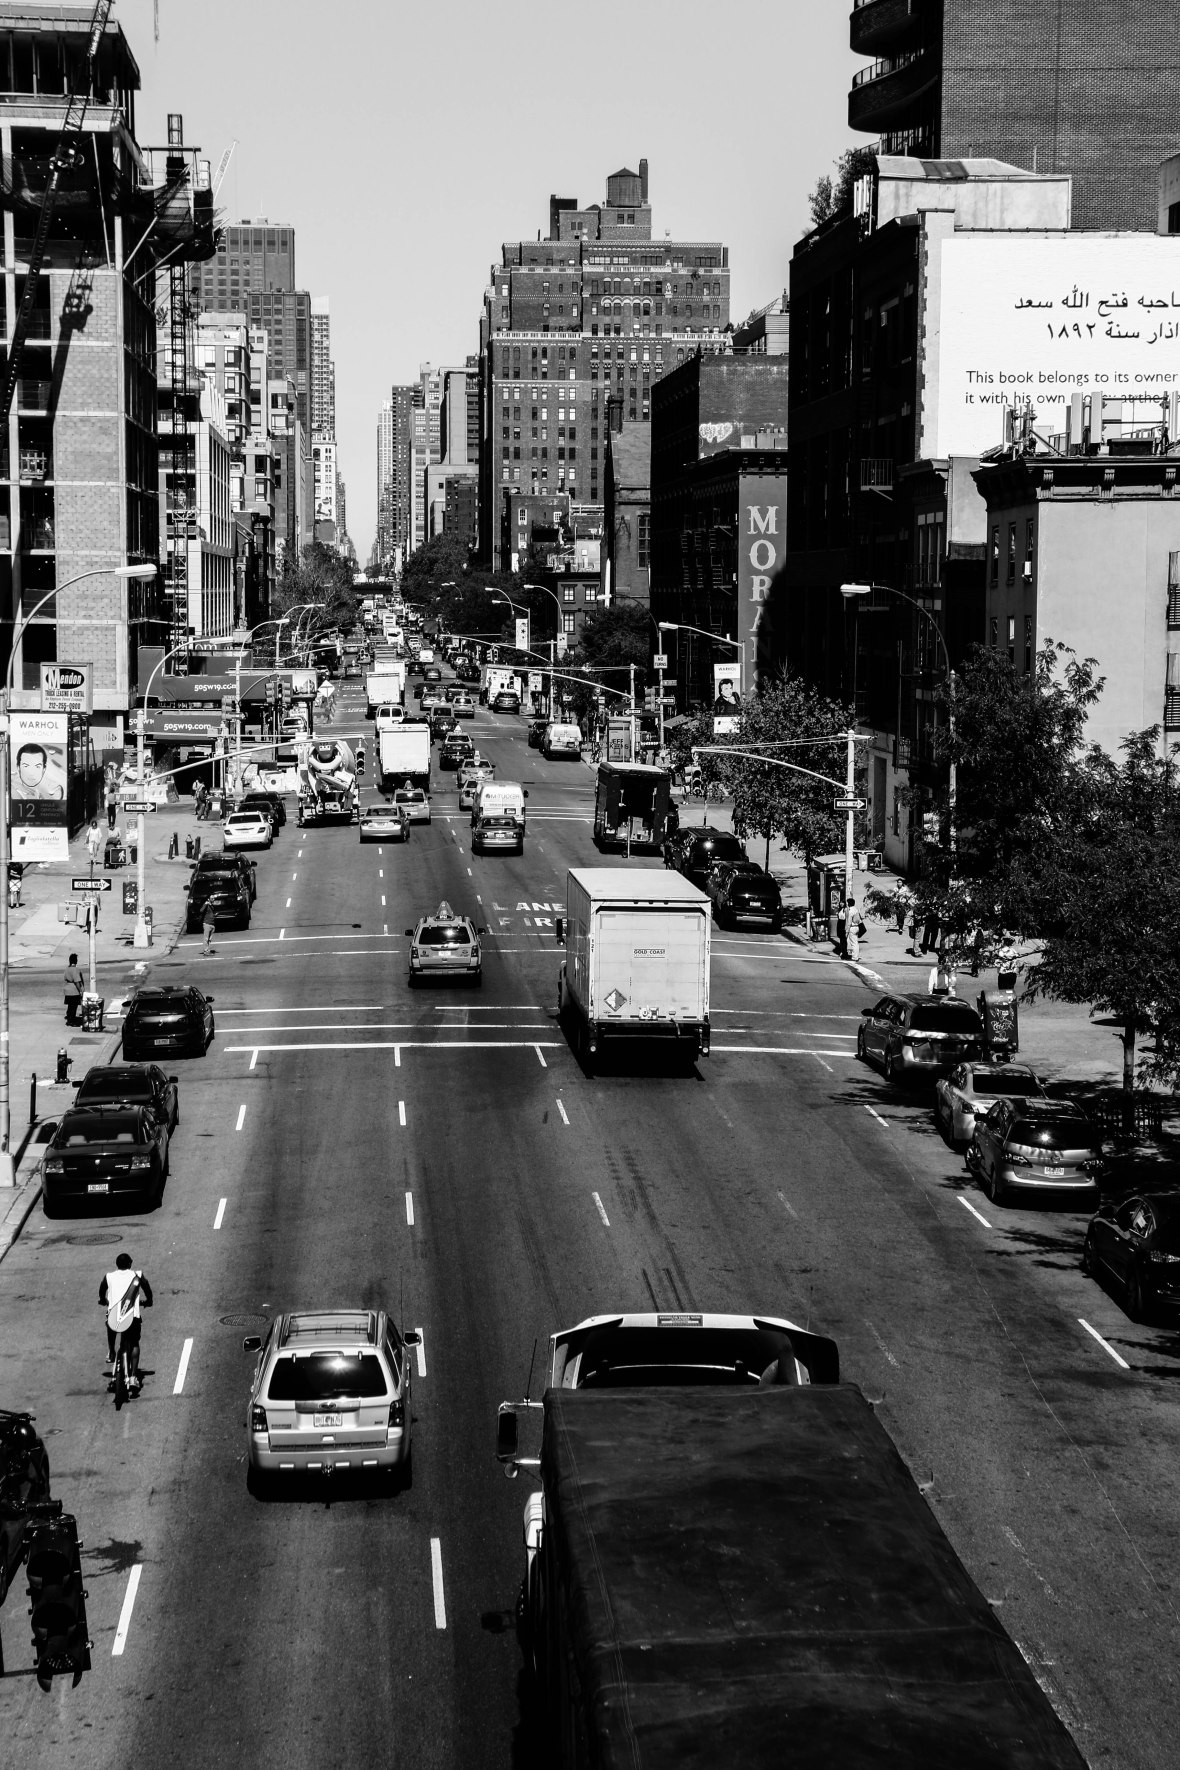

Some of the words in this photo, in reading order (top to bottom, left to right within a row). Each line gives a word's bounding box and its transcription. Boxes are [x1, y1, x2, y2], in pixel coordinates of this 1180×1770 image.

[1014, 296, 1053, 309] سعد
[1061, 284, 1090, 309] الله
[1097, 291, 1129, 317] فتح
[1137, 291, 1180, 314] احبه
[1046, 321, 1096, 340] ١٨٩٢
[1105, 320, 1140, 339] سنة
[966, 370, 994, 384] This
[999, 370, 1034, 384] book
[1038, 370, 1090, 387] belongs
[1094, 372, 1109, 384] to
[1114, 370, 1129, 384] its
[1134, 372, 1179, 384] owner
[965, 391, 975, 404] it
[979, 391, 1009, 405] with
[1013, 391, 1032, 404] his
[1036, 394, 1066, 404] own
[48, 667, 82, 690] Mendon
[19, 720, 60, 730] WARHOL
[18, 803, 36, 818] 12
